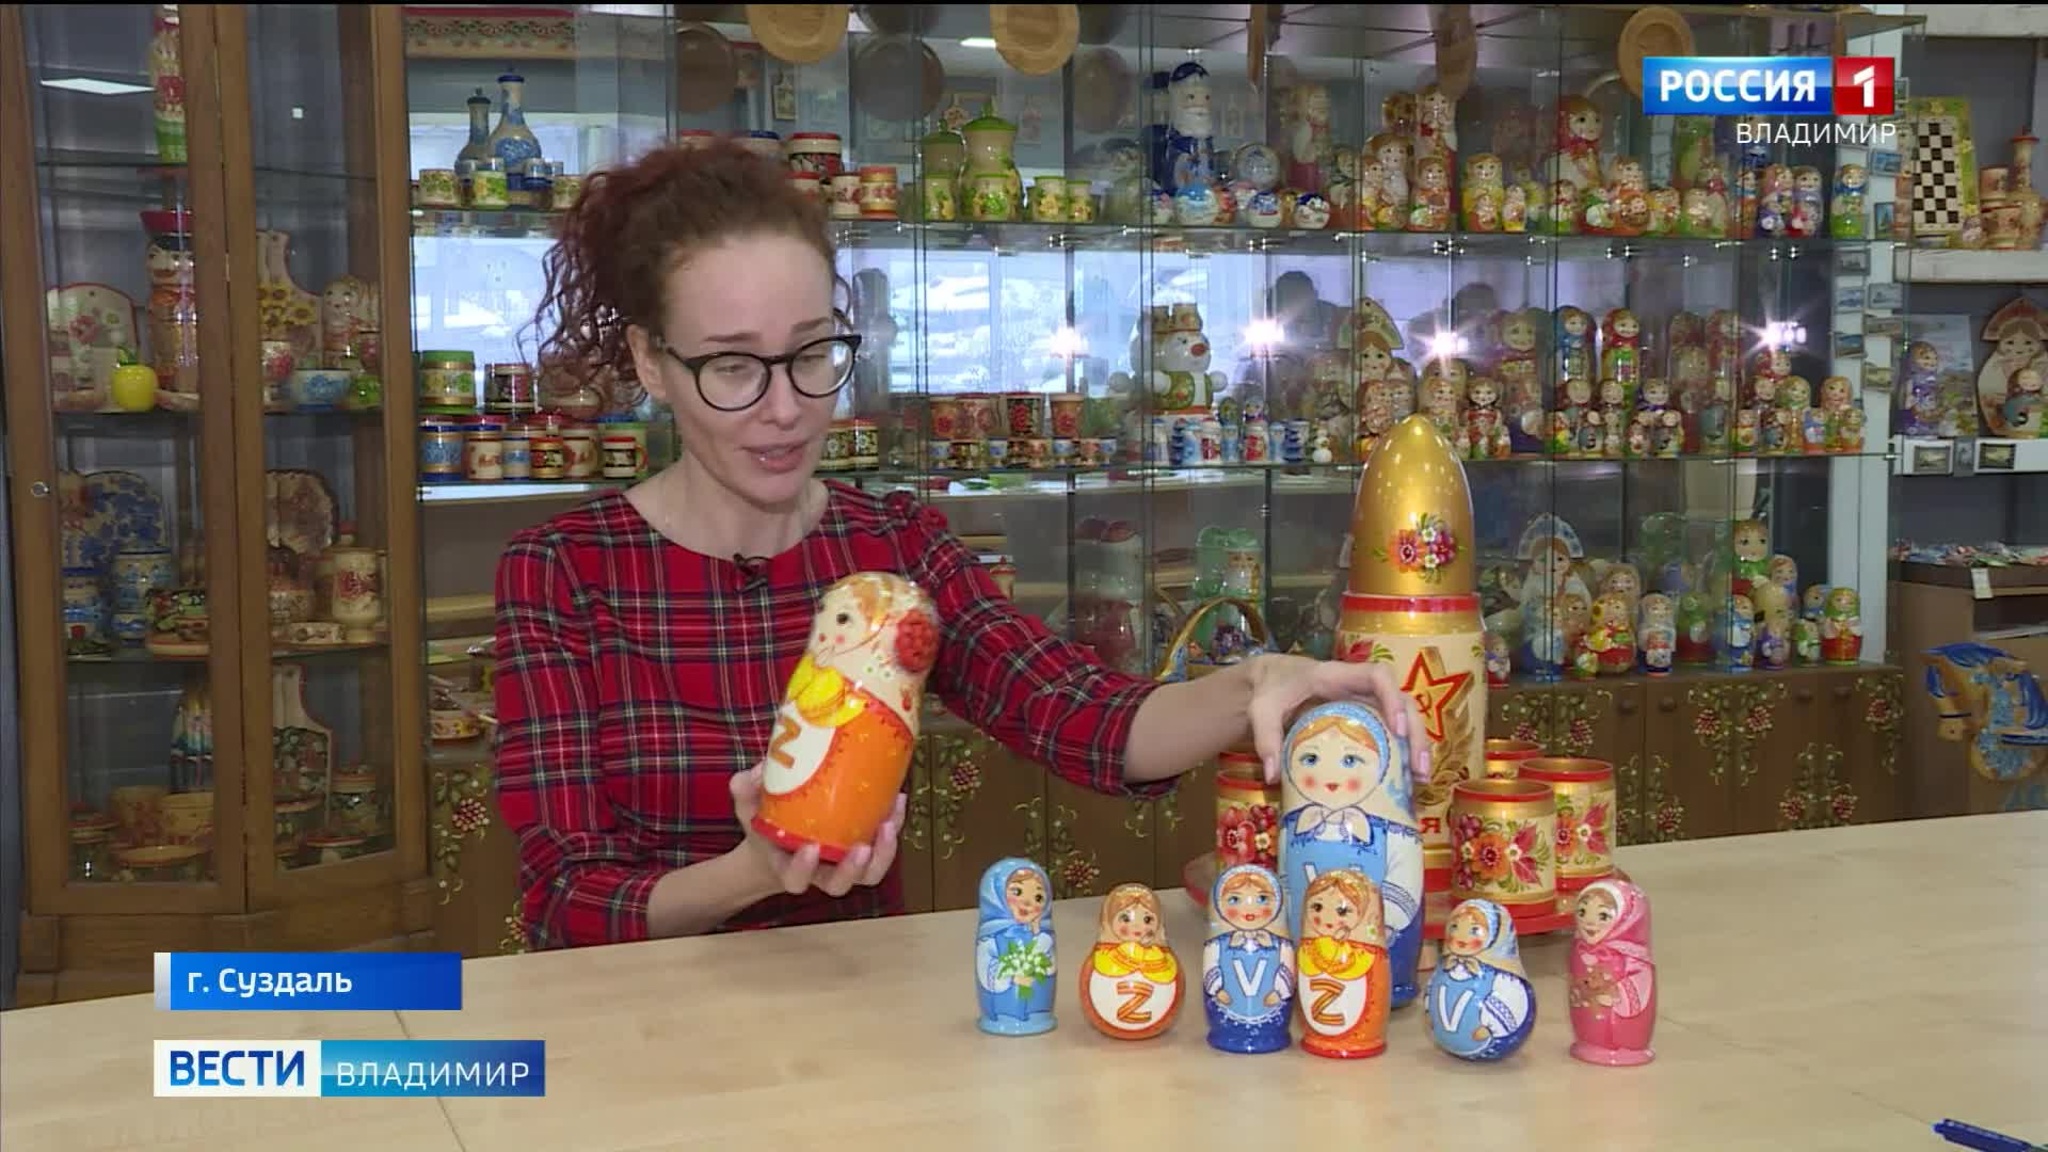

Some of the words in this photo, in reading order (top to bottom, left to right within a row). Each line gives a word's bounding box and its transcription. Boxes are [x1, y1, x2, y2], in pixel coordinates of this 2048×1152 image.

[1232, 958, 1268, 996] V
[1116, 981, 1153, 1023] Z
[1309, 980, 1346, 1026] Z
[1438, 984, 1474, 1033] V
